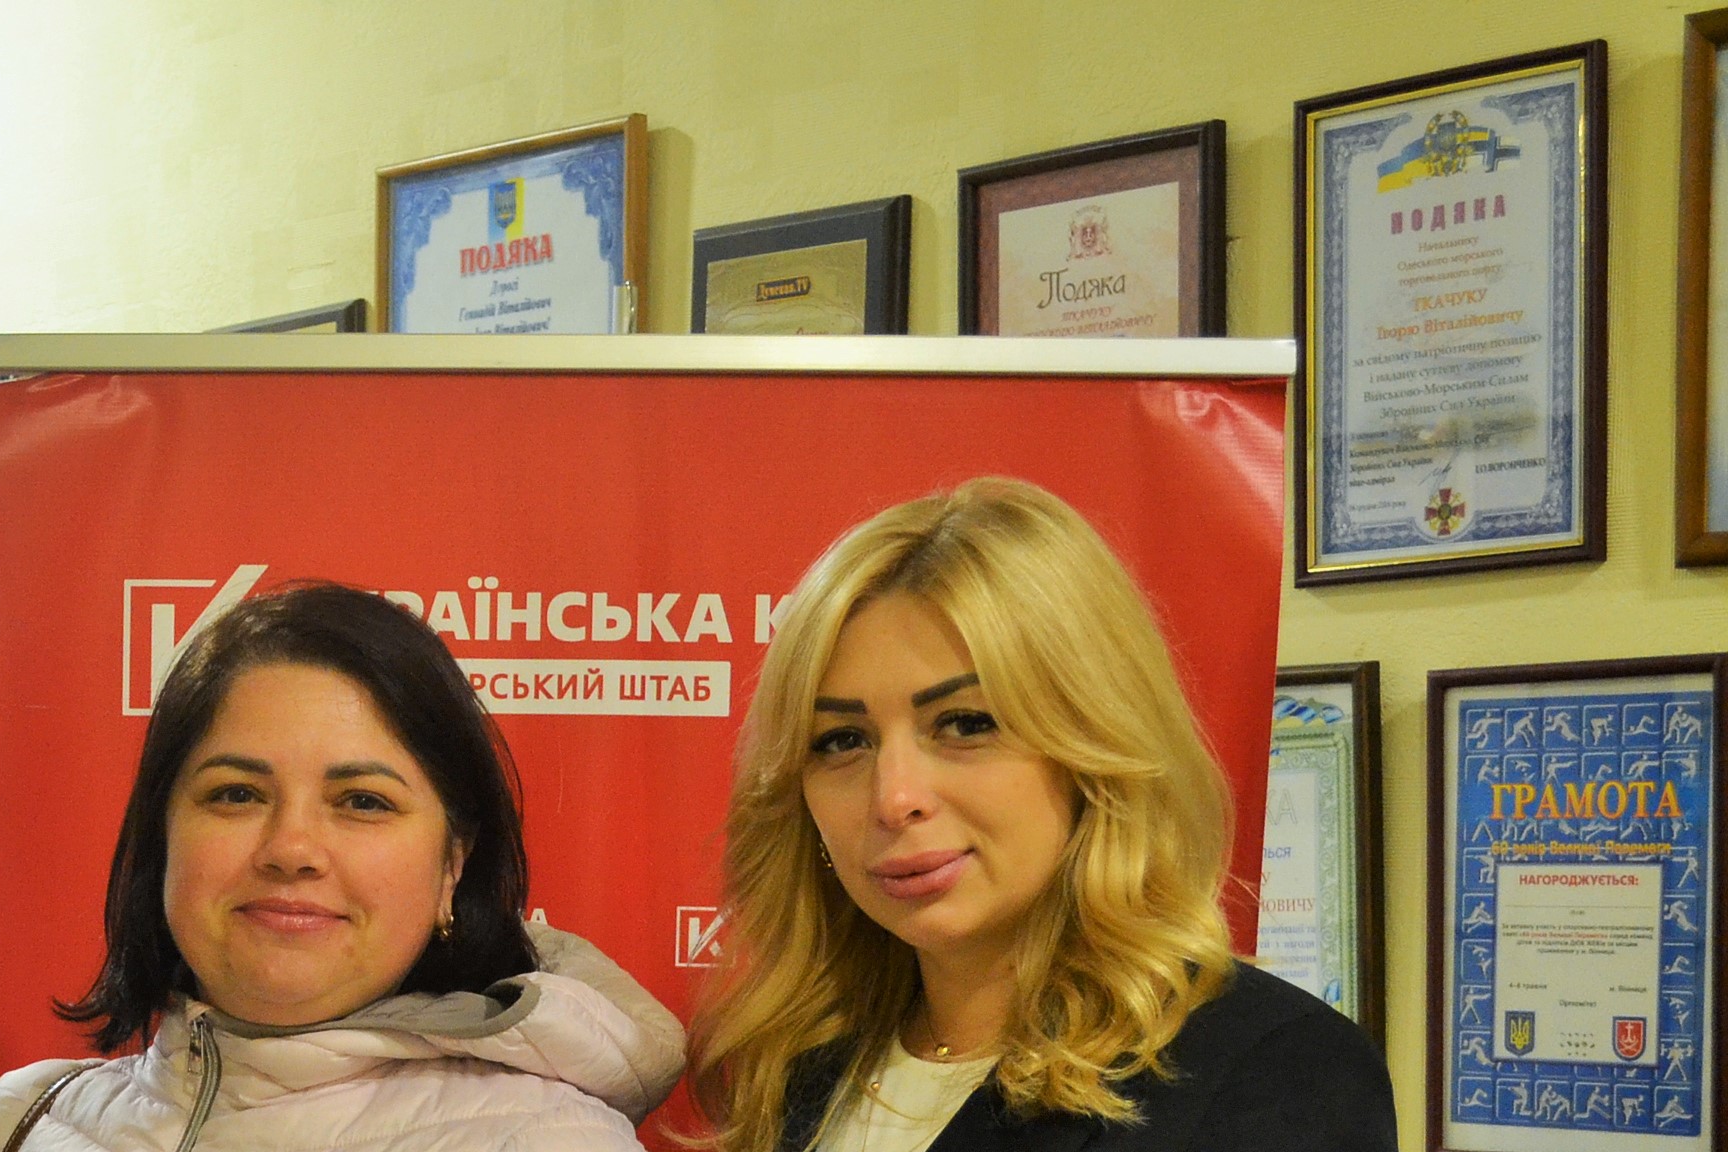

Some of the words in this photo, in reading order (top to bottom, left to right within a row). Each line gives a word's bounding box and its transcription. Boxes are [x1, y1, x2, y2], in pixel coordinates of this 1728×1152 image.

[1391, 194, 1506, 234] ПОДЯКА
[460, 233, 553, 277] ПОДЯКА
[1036, 267, 1127, 310] Подяка
[365, 576, 732, 643] АЇНСЬКА
[619, 674, 711, 701] ШТАБ
[1489, 780, 1683, 821] ГРАМОТА
[1519, 874, 1639, 887] НАГОРОДЖУЄТЬСЯ:
